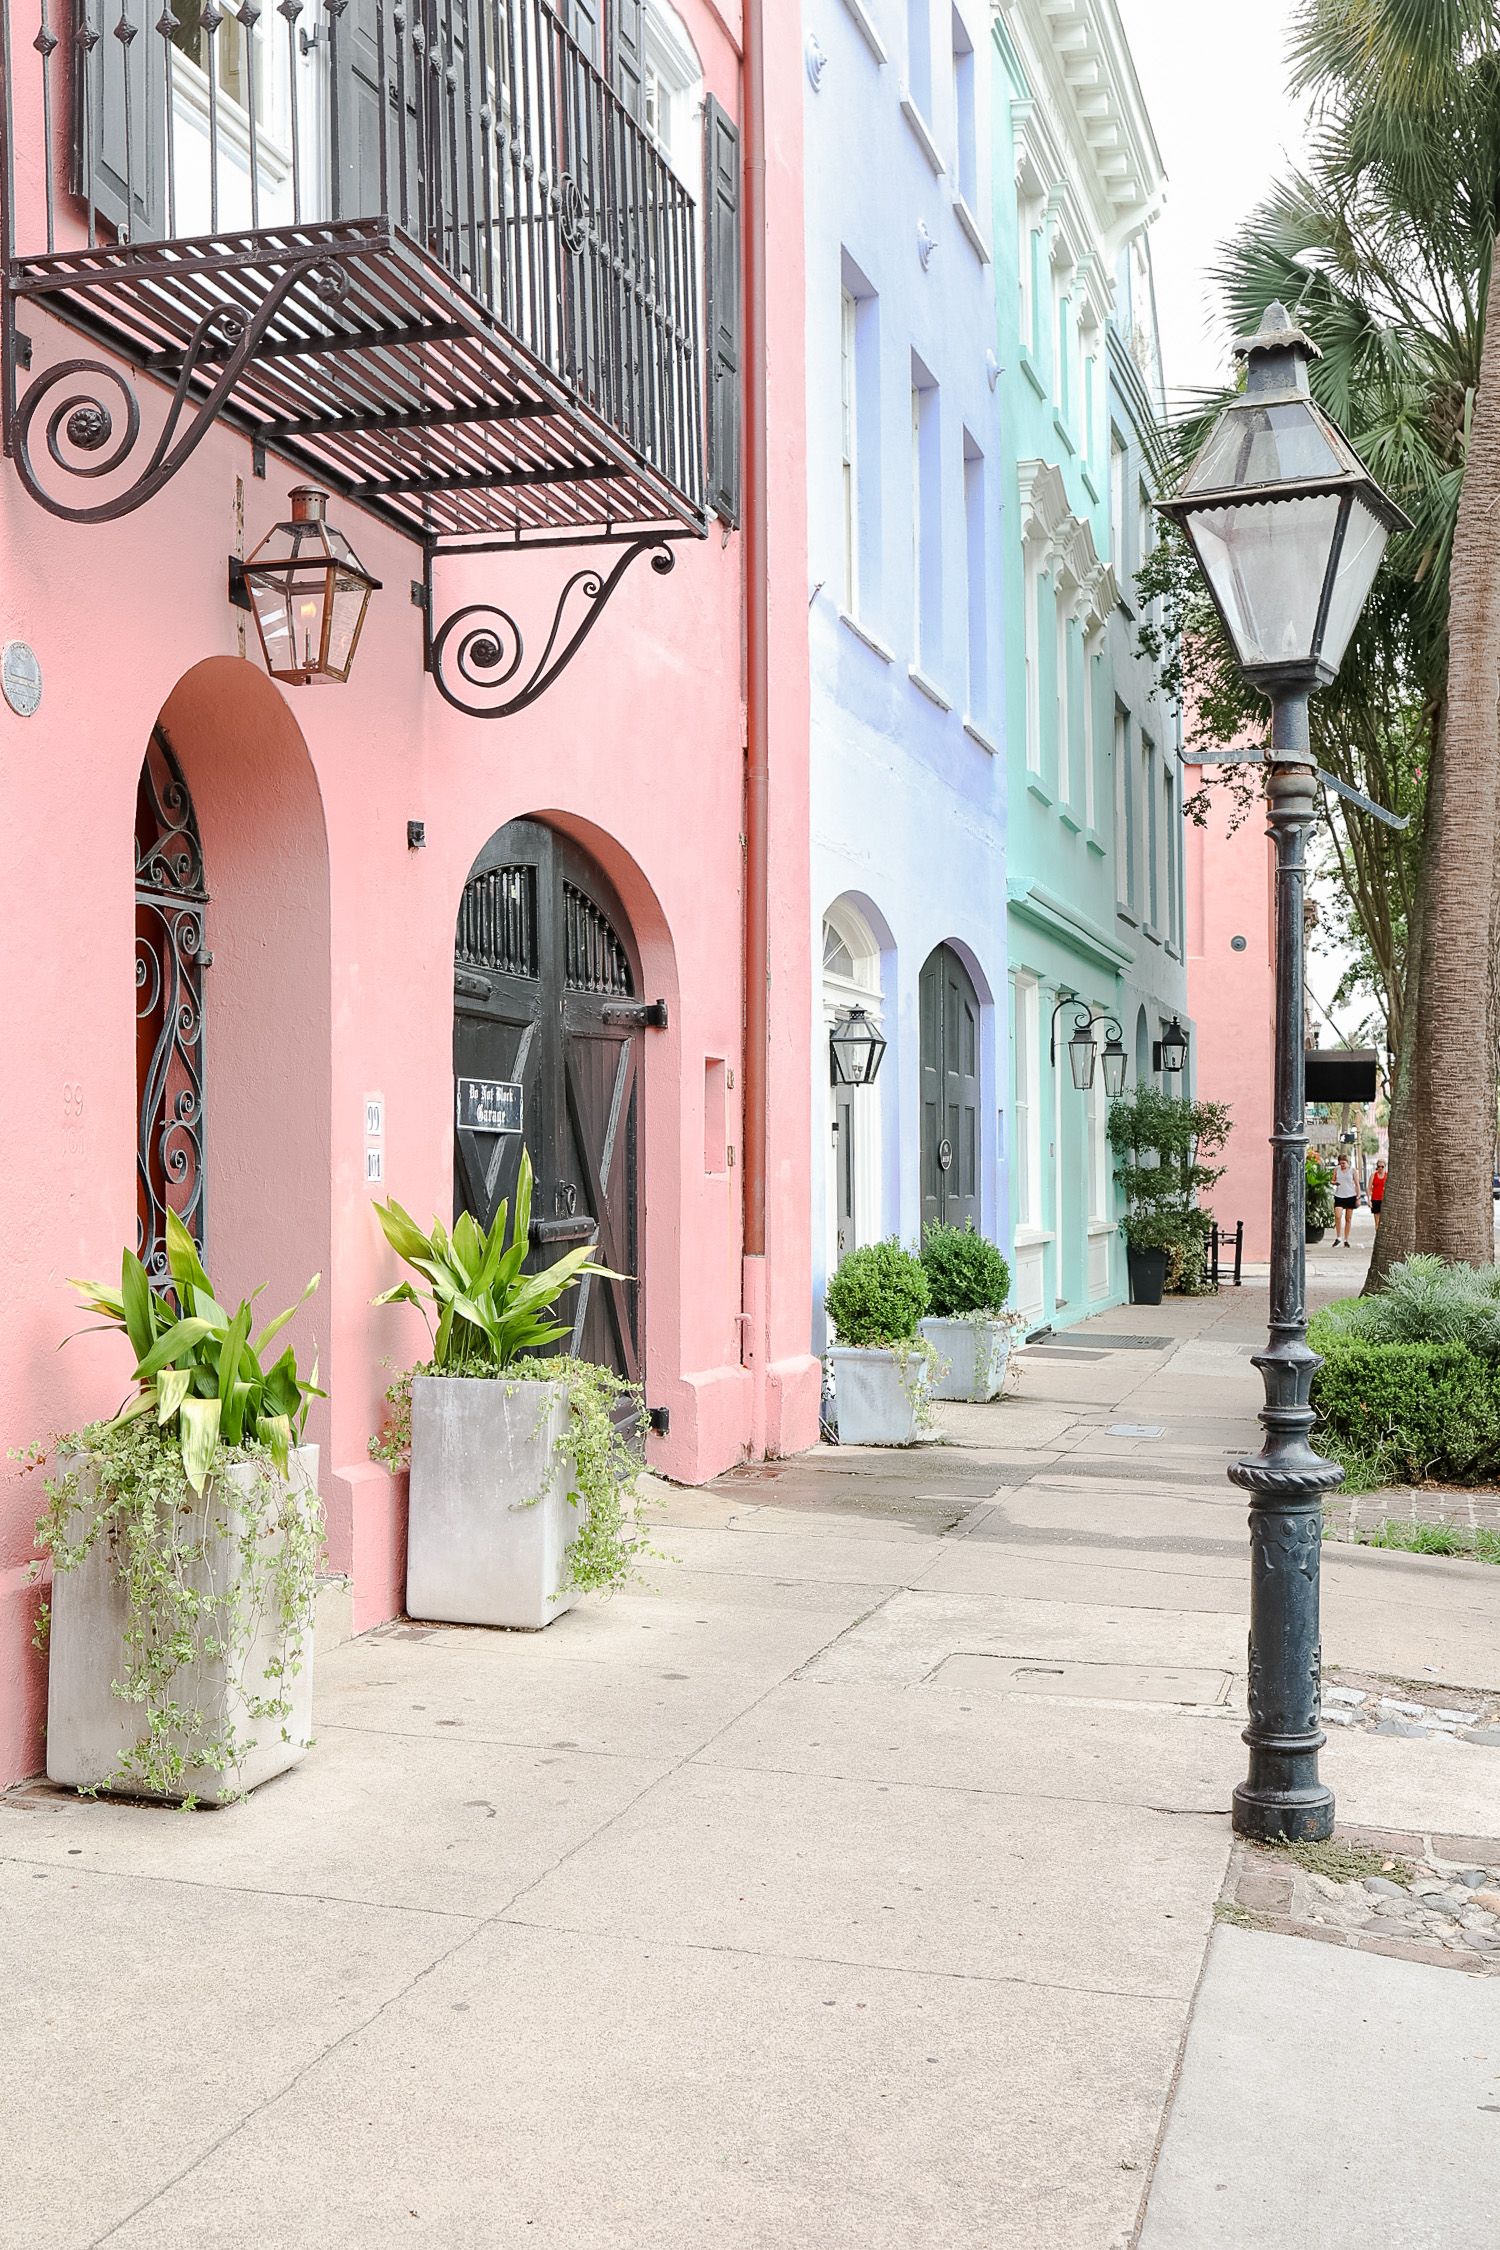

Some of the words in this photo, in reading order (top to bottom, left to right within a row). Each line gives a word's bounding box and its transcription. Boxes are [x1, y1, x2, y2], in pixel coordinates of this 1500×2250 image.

[469, 1084, 479, 1099] Do
[481, 1084, 494, 1103] Not
[496, 1086, 513, 1102] Block
[367, 1105, 380, 1131] 99
[476, 1104, 506, 1126] Garage
[367, 1153, 381, 1177] 101
